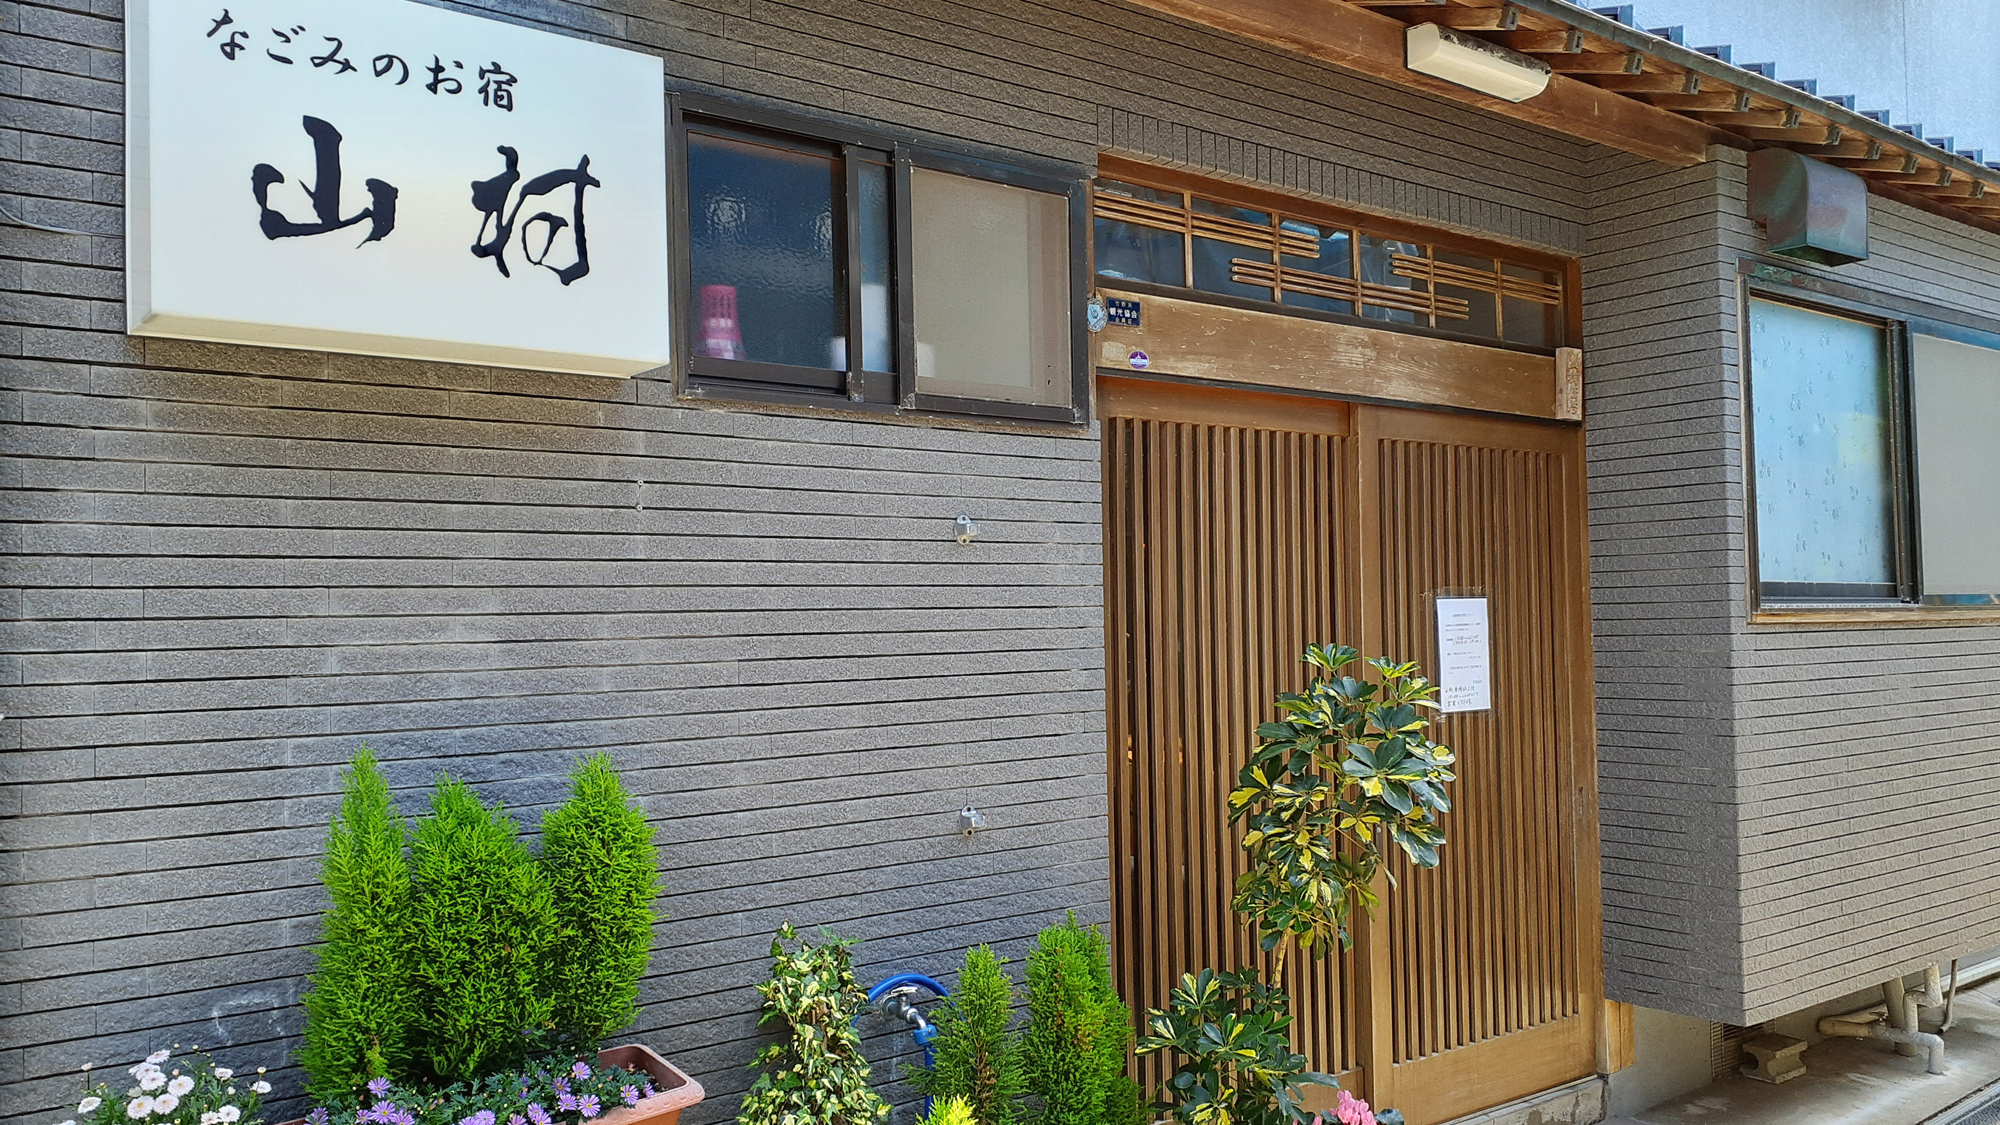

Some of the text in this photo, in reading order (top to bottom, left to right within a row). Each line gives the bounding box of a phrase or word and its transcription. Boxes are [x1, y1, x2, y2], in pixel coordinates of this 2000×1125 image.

[206, 8, 518, 112] なごみのお宿
[251, 115, 601, 286] 山村
[1110, 307, 1137, 319] 観光協会
